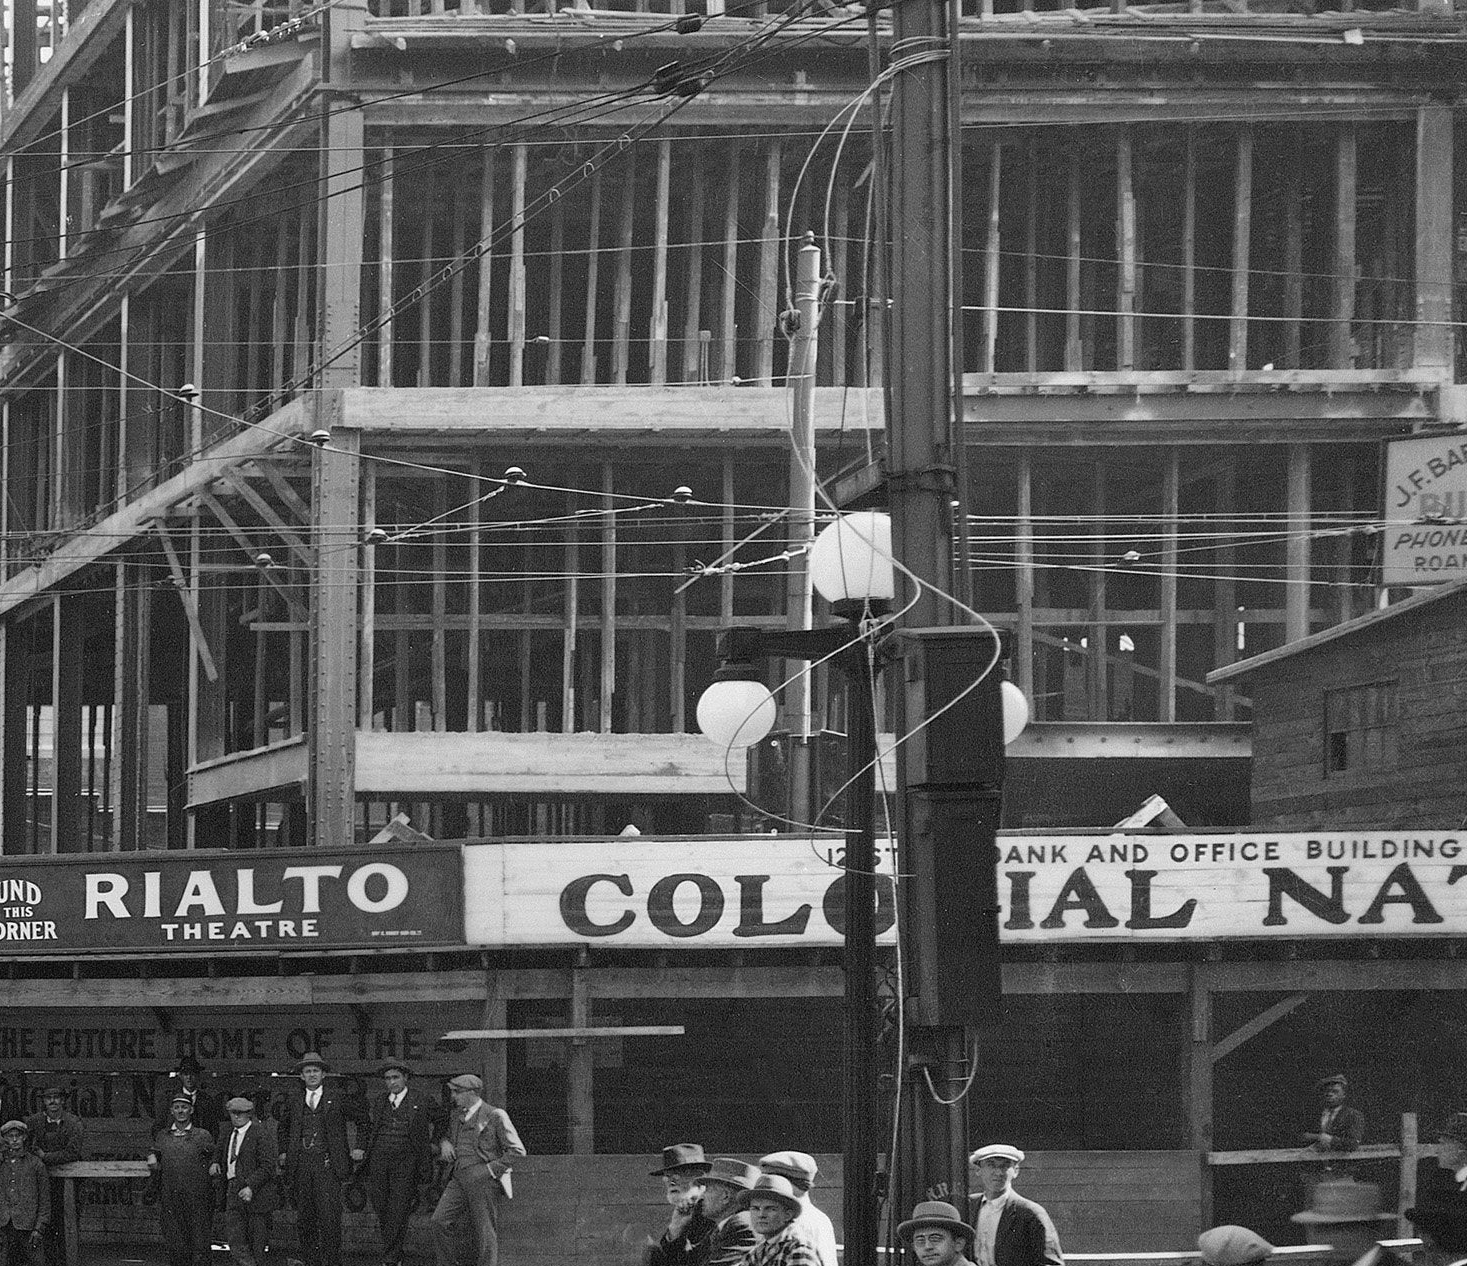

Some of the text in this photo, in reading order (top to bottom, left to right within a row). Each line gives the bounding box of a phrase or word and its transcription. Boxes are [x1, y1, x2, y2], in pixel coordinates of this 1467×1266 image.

[1085, 843, 1150, 864] AND
[1170, 841, 1280, 863] OFFICE
[1306, 838, 1462, 861] BUILDING
[84, 862, 409, 920] RIALTO
[559, 866, 1198, 938] COLOIAL
[3, 906, 34, 918] THIS
[161, 919, 319, 940] THEATRE
[46, 1027, 157, 1059] FUTURE
[176, 1027, 267, 1059] HOME
[285, 1027, 335, 1060] OF
[353, 1027, 423, 1061] THE
